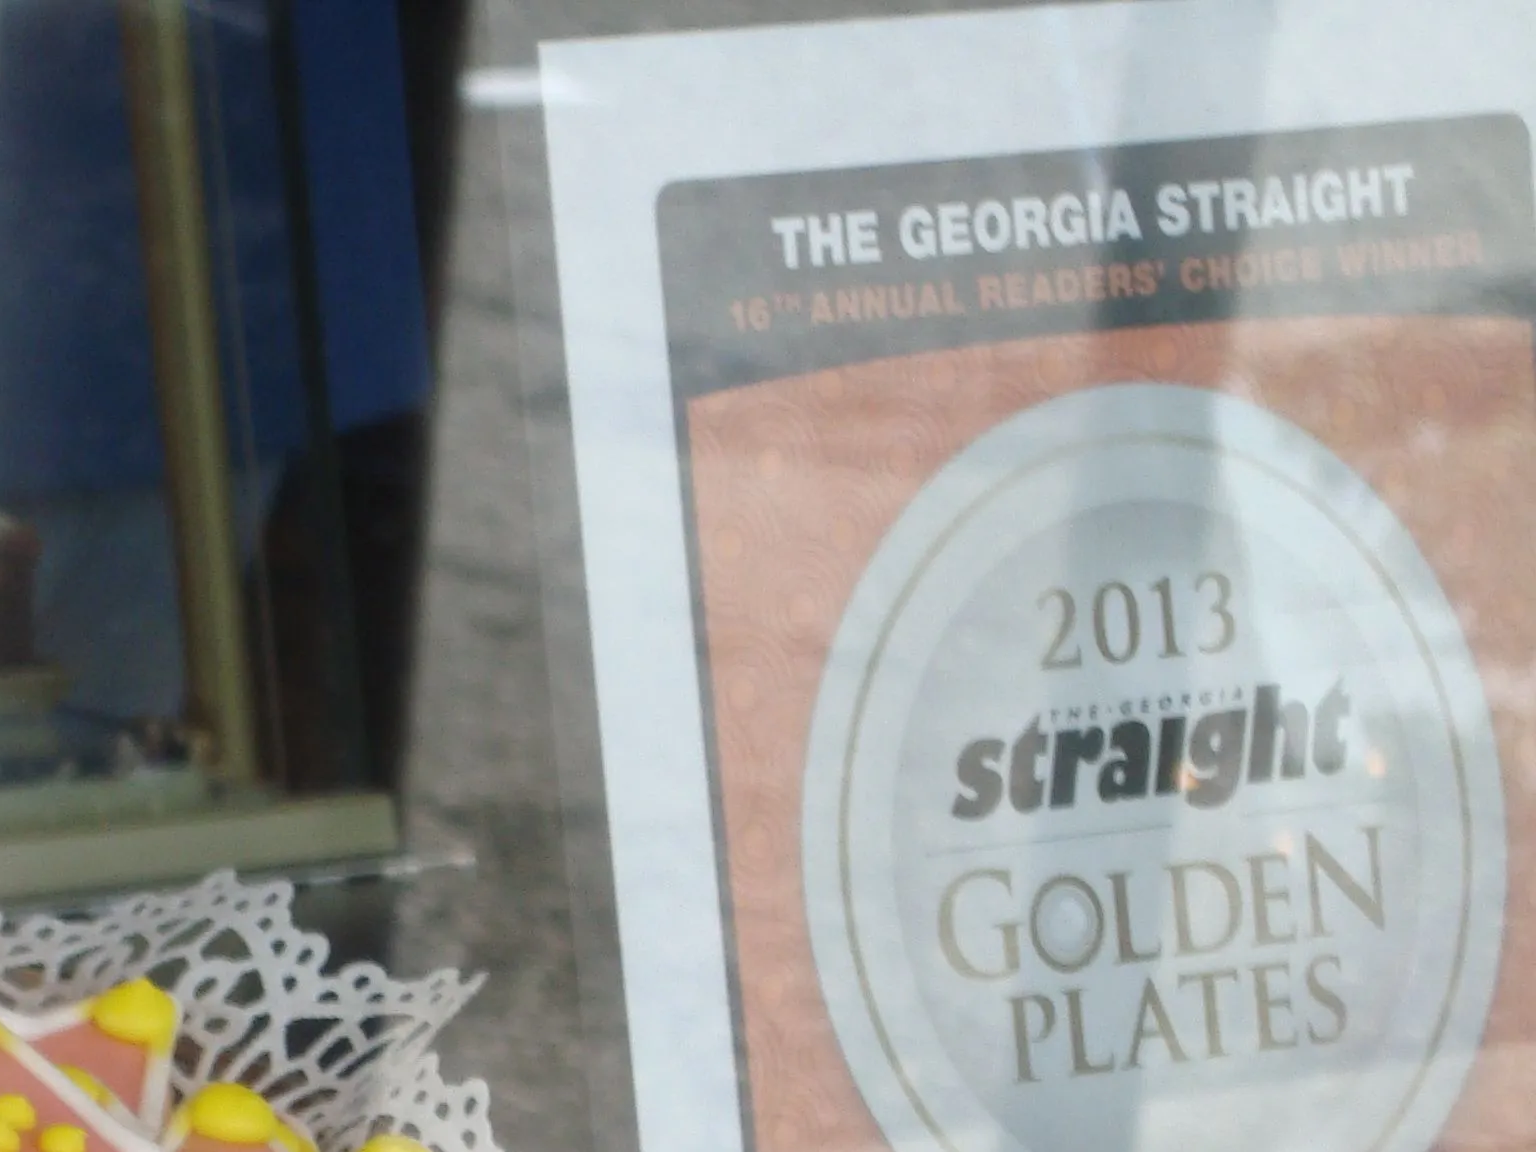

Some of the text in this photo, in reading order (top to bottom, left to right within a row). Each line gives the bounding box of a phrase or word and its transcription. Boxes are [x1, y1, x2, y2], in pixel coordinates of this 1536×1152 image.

[771, 163, 1414, 270] THE GEORGIA STRAIGHT
[810, 281, 963, 325] ANNUAL
[976, 260, 1164, 311] READERS'
[1180, 245, 1321, 293] CHOICE
[1337, 230, 1483, 278] WINNER
[1037, 570, 1237, 673] 2013
[950, 672, 1352, 822] straight
[937, 825, 1386, 981] GOLDEN
[1006, 954, 1349, 1085] PLATES
